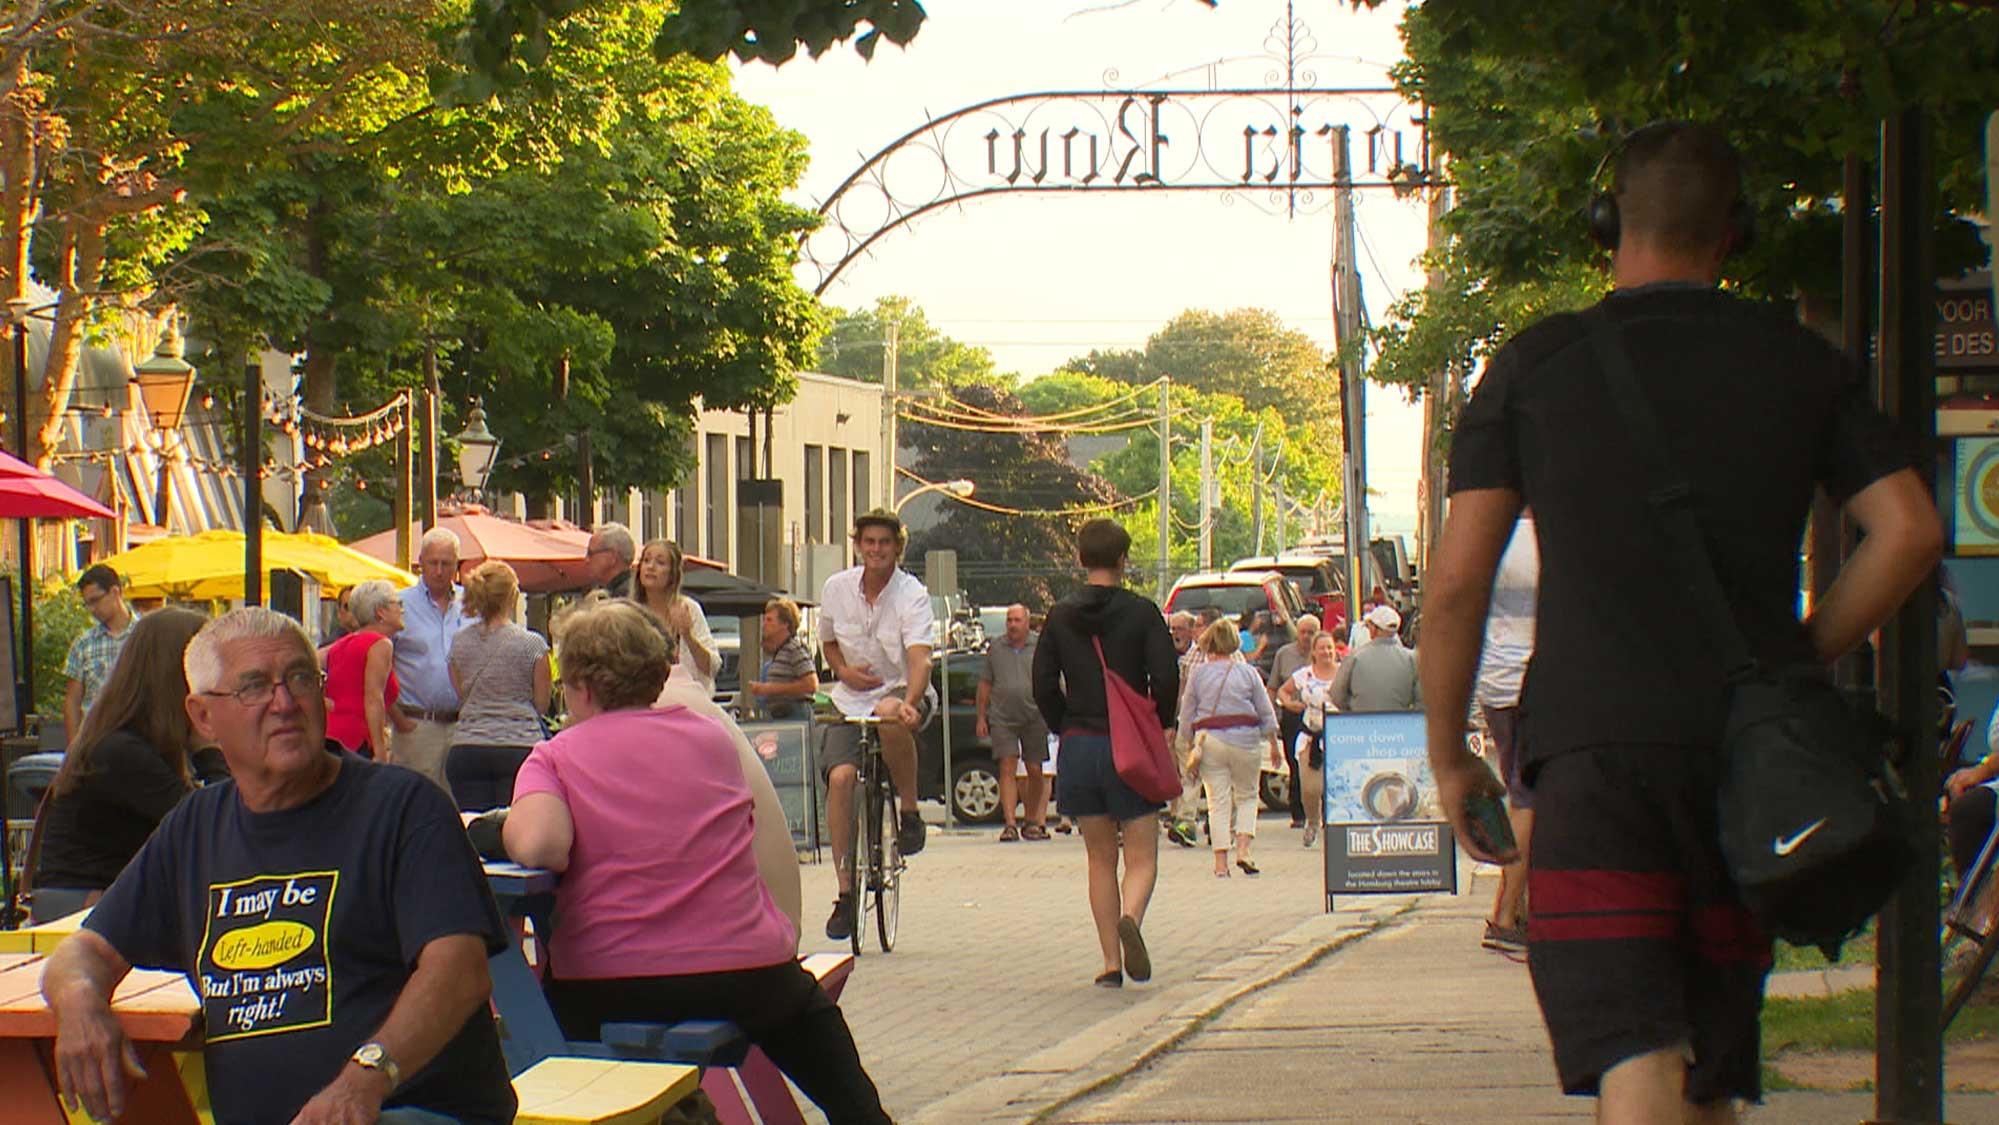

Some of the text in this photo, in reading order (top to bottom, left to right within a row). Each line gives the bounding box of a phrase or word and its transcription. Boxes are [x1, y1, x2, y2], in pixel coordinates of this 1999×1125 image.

[1937, 300, 1988, 323] OOR
[1330, 729, 1404, 744] come down
[1366, 745, 1396, 758] shop
[1351, 827, 1434, 854] THE SHOWCASE
[217, 879, 317, 919] I may be
[220, 928, 304, 963] Left-handed
[202, 966, 326, 998] But I'm always
[228, 992, 286, 1030] right!
